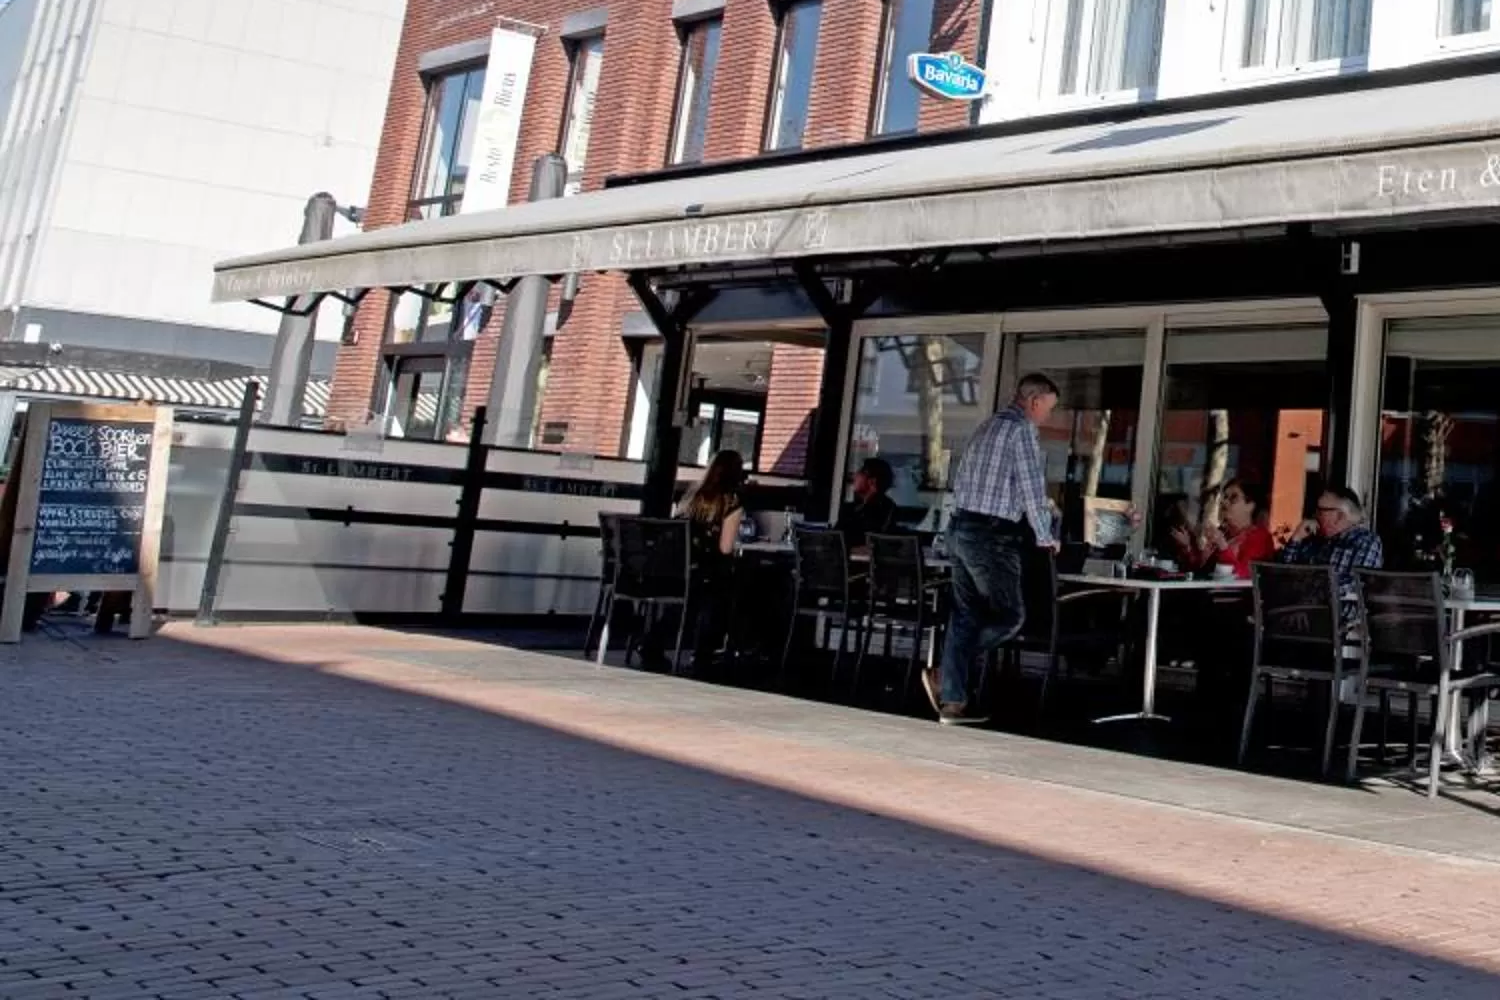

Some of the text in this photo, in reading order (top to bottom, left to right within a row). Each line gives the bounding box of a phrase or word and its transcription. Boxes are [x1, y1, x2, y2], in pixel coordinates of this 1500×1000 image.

[923, 63, 979, 91] Bavaria
[1378, 164, 1457, 197] Eten
[644, 218, 784, 259] LAMBERT
